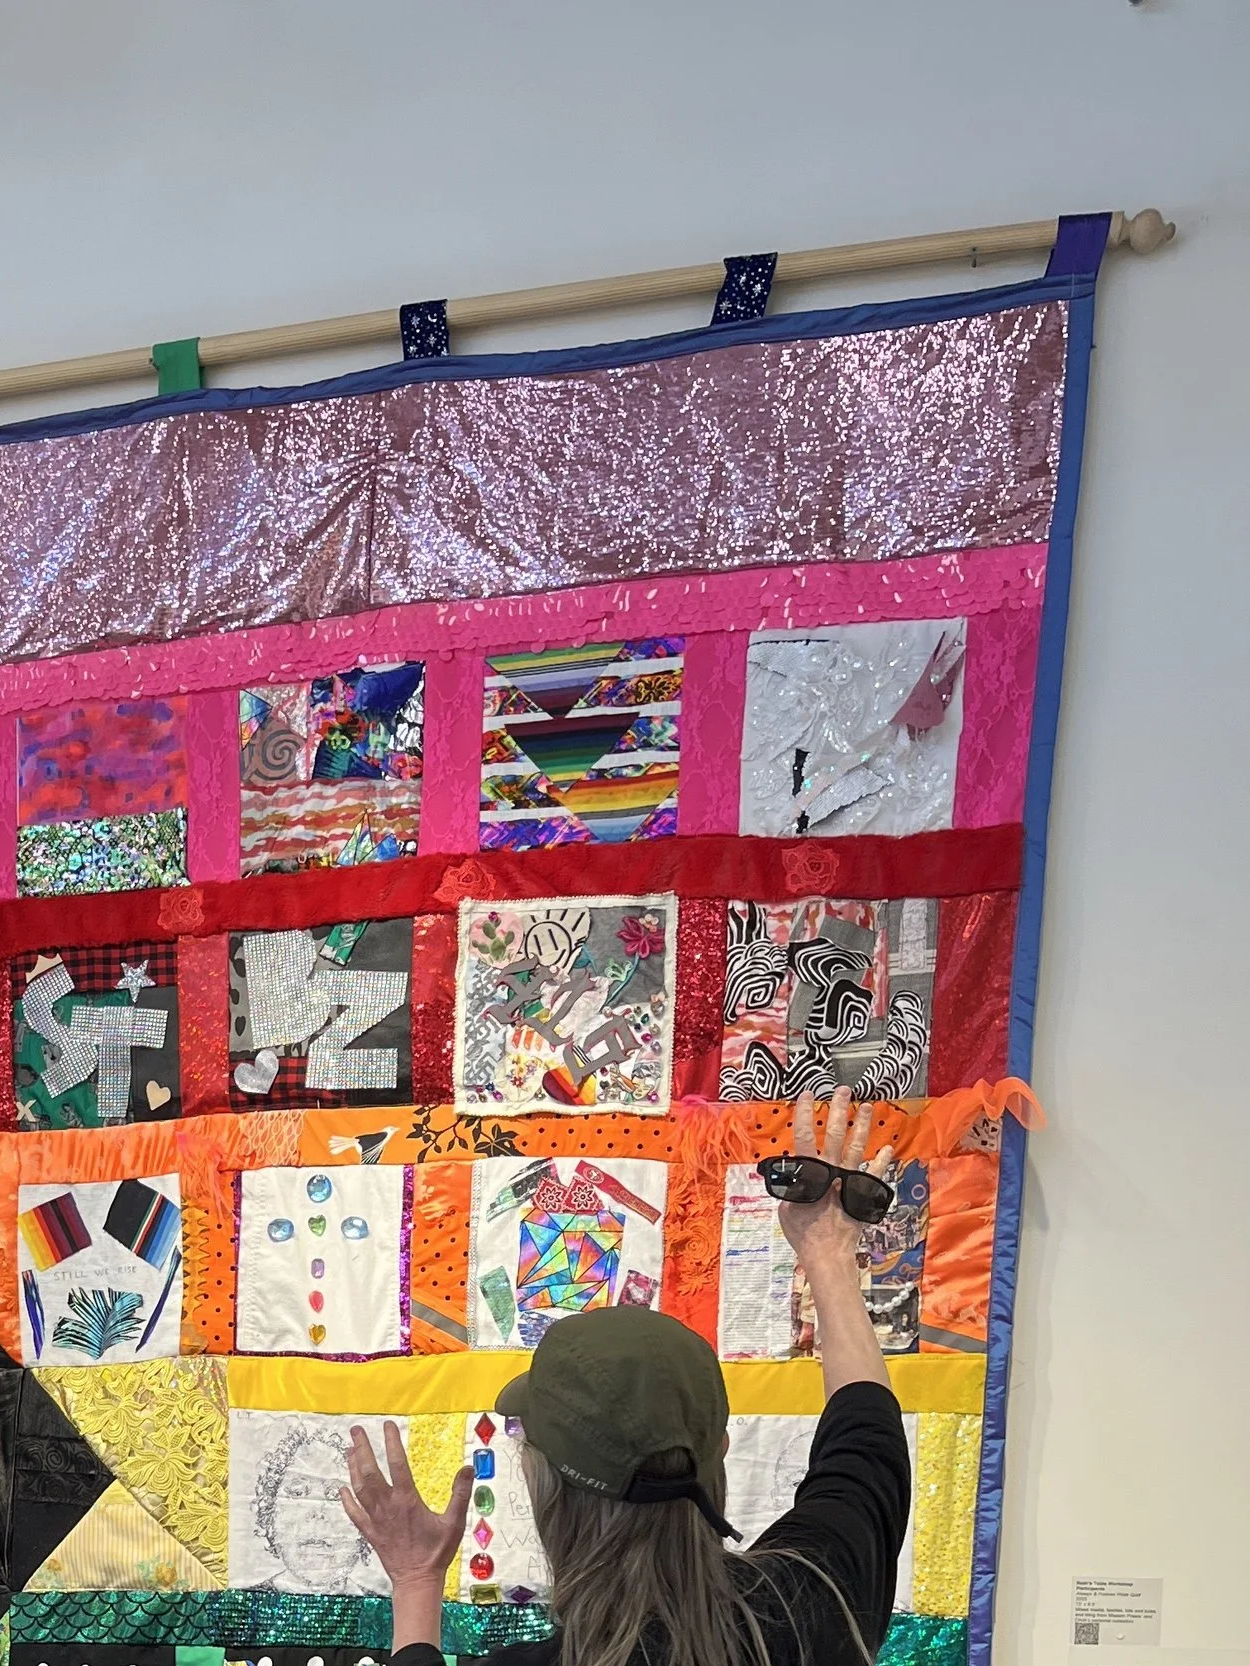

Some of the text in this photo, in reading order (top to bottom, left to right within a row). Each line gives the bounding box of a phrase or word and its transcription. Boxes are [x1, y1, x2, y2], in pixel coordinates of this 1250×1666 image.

[53, 1265, 138, 1282] STILL WE RISE
[560, 1463, 608, 1491] DRI-FIT
